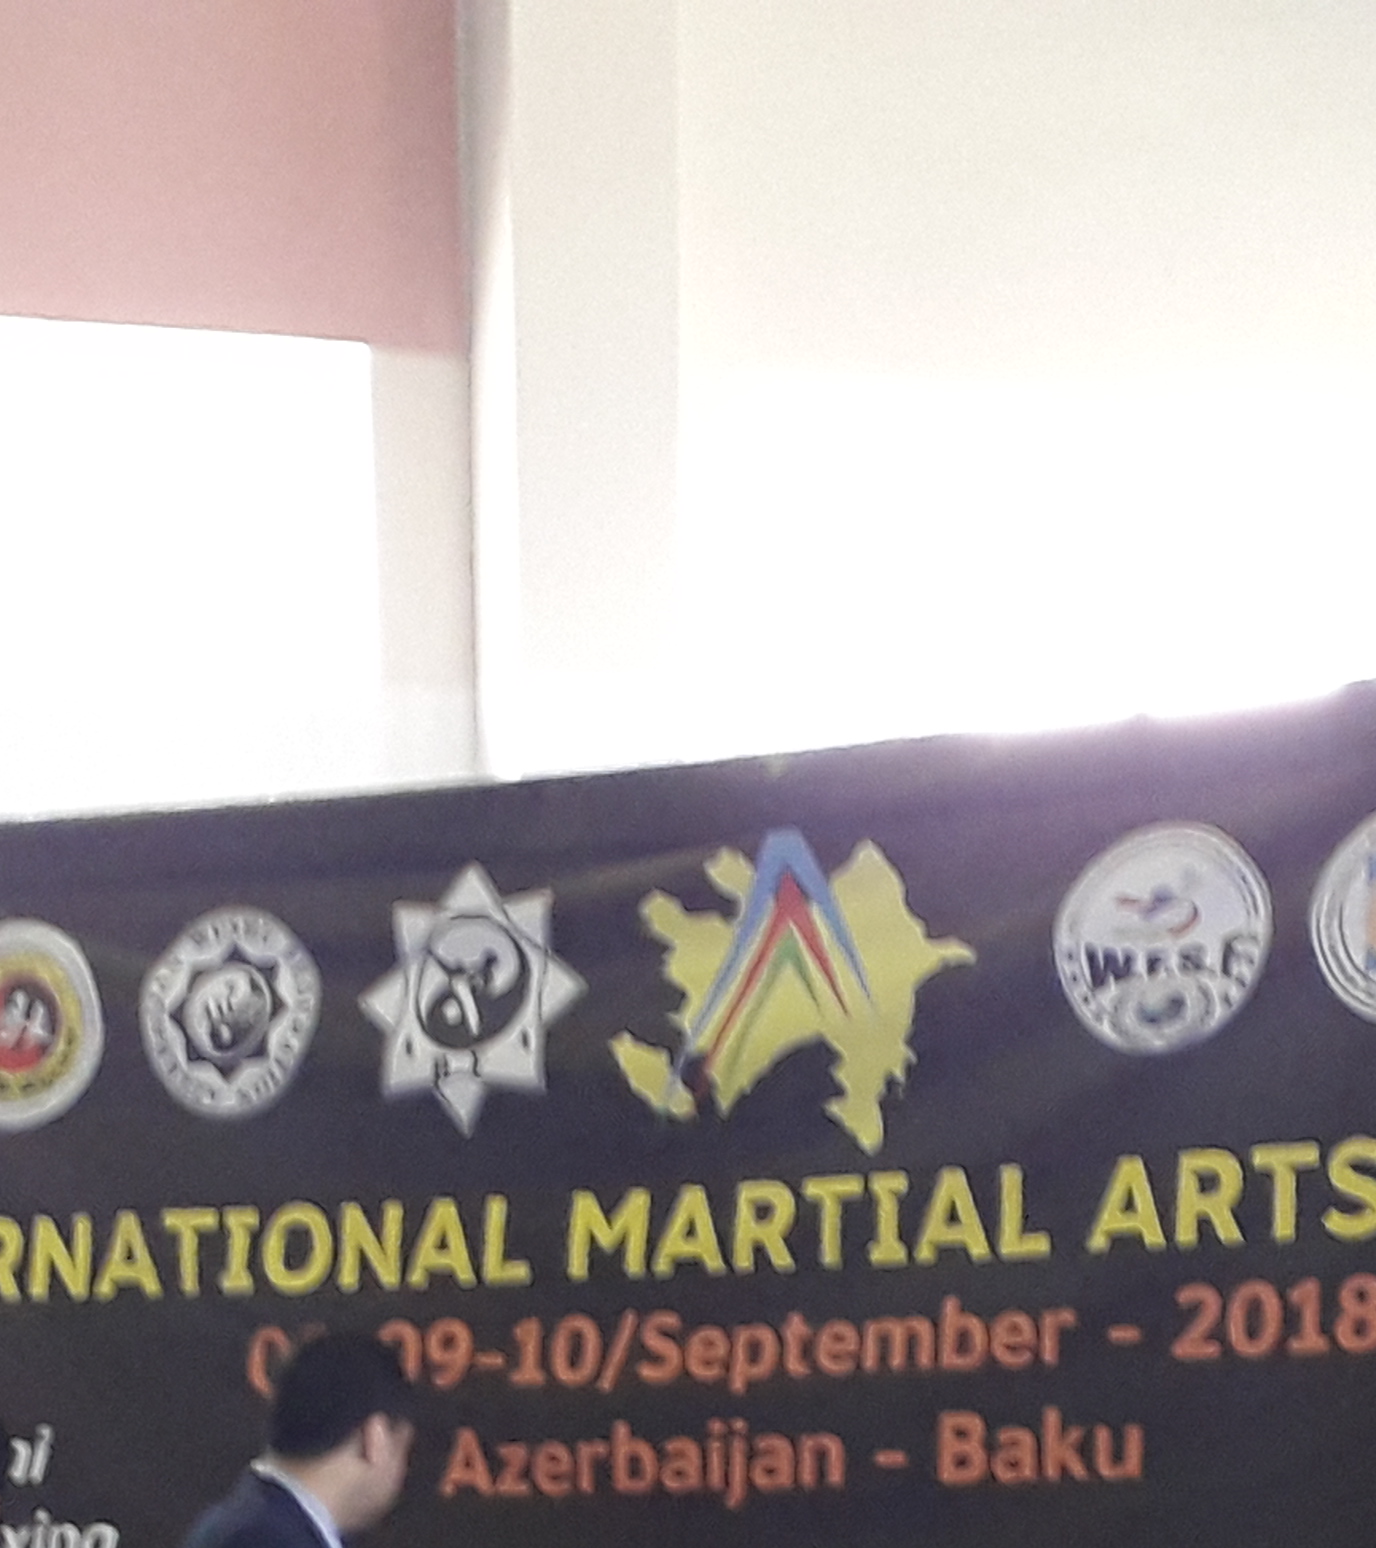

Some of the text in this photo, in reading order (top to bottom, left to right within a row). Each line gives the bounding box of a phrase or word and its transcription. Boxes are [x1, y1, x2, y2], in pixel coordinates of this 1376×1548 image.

[566, 1163, 1052, 1282] MARTIAL
[440, 1418, 846, 1509] Azerbaijan
[935, 1407, 1145, 1488] Baku
